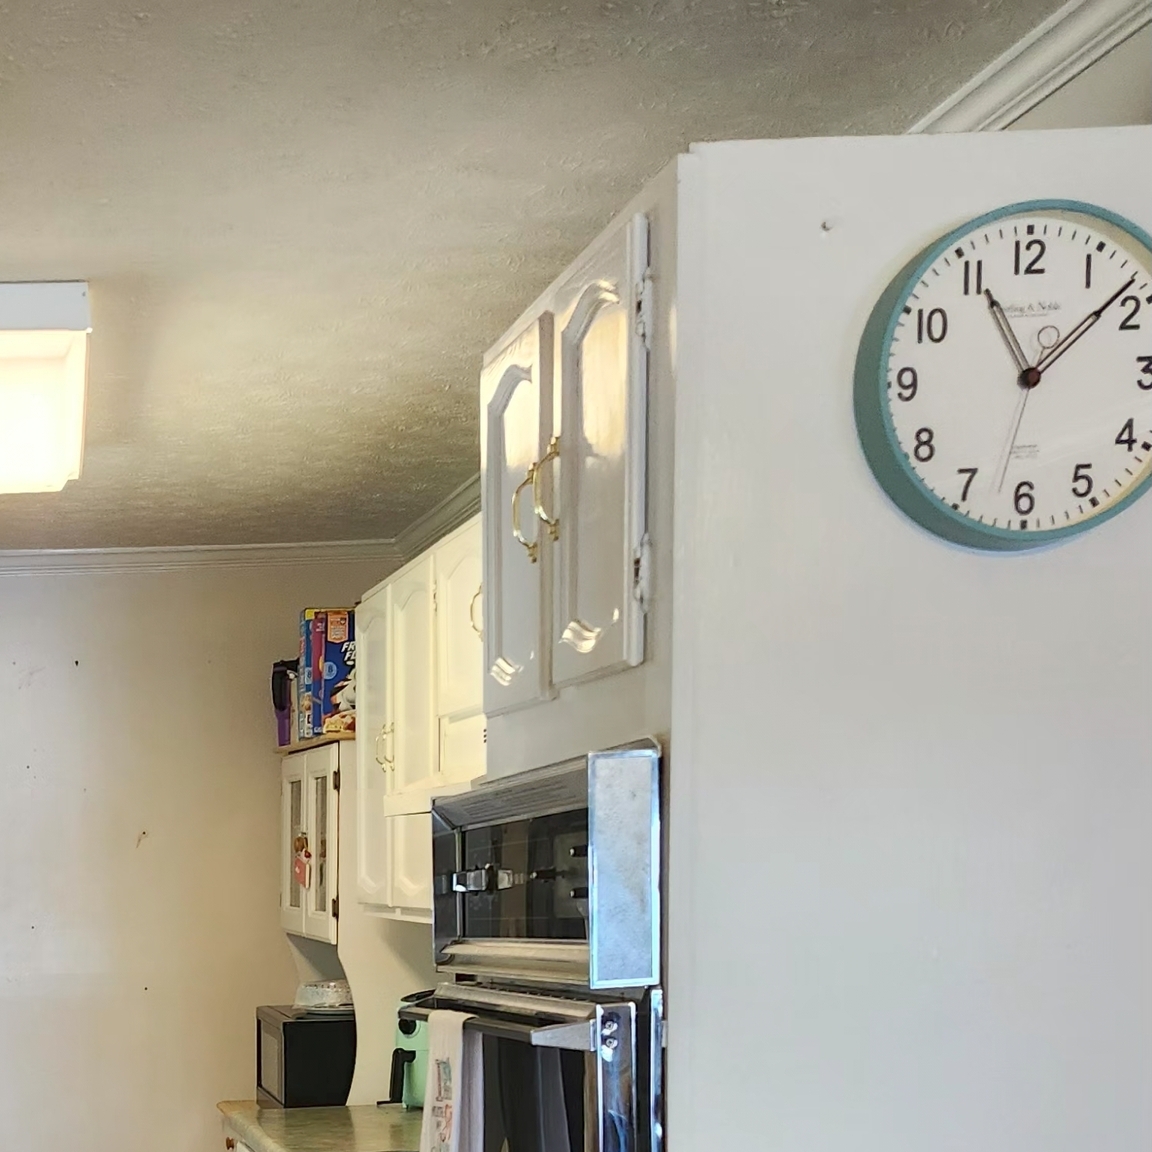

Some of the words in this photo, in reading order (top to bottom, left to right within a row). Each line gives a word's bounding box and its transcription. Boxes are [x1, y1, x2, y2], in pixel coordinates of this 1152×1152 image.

[1014, 239, 1046, 275] 12
[1085, 253, 1092, 289] 1
[963, 260, 983, 295] 11
[917, 307, 948, 344] 10
[1118, 295, 1141, 331] 2
[896, 367, 918, 402] 9
[1136, 356, 1152, 390] 3
[914, 428, 935, 462] 8
[1115, 418, 1137, 452] 4
[958, 468, 978, 502] 7
[1072, 463, 1094, 498] 5
[1014, 481, 1034, 515] 6
[341, 641, 356, 653] FR
[344, 651, 356, 662] FL
